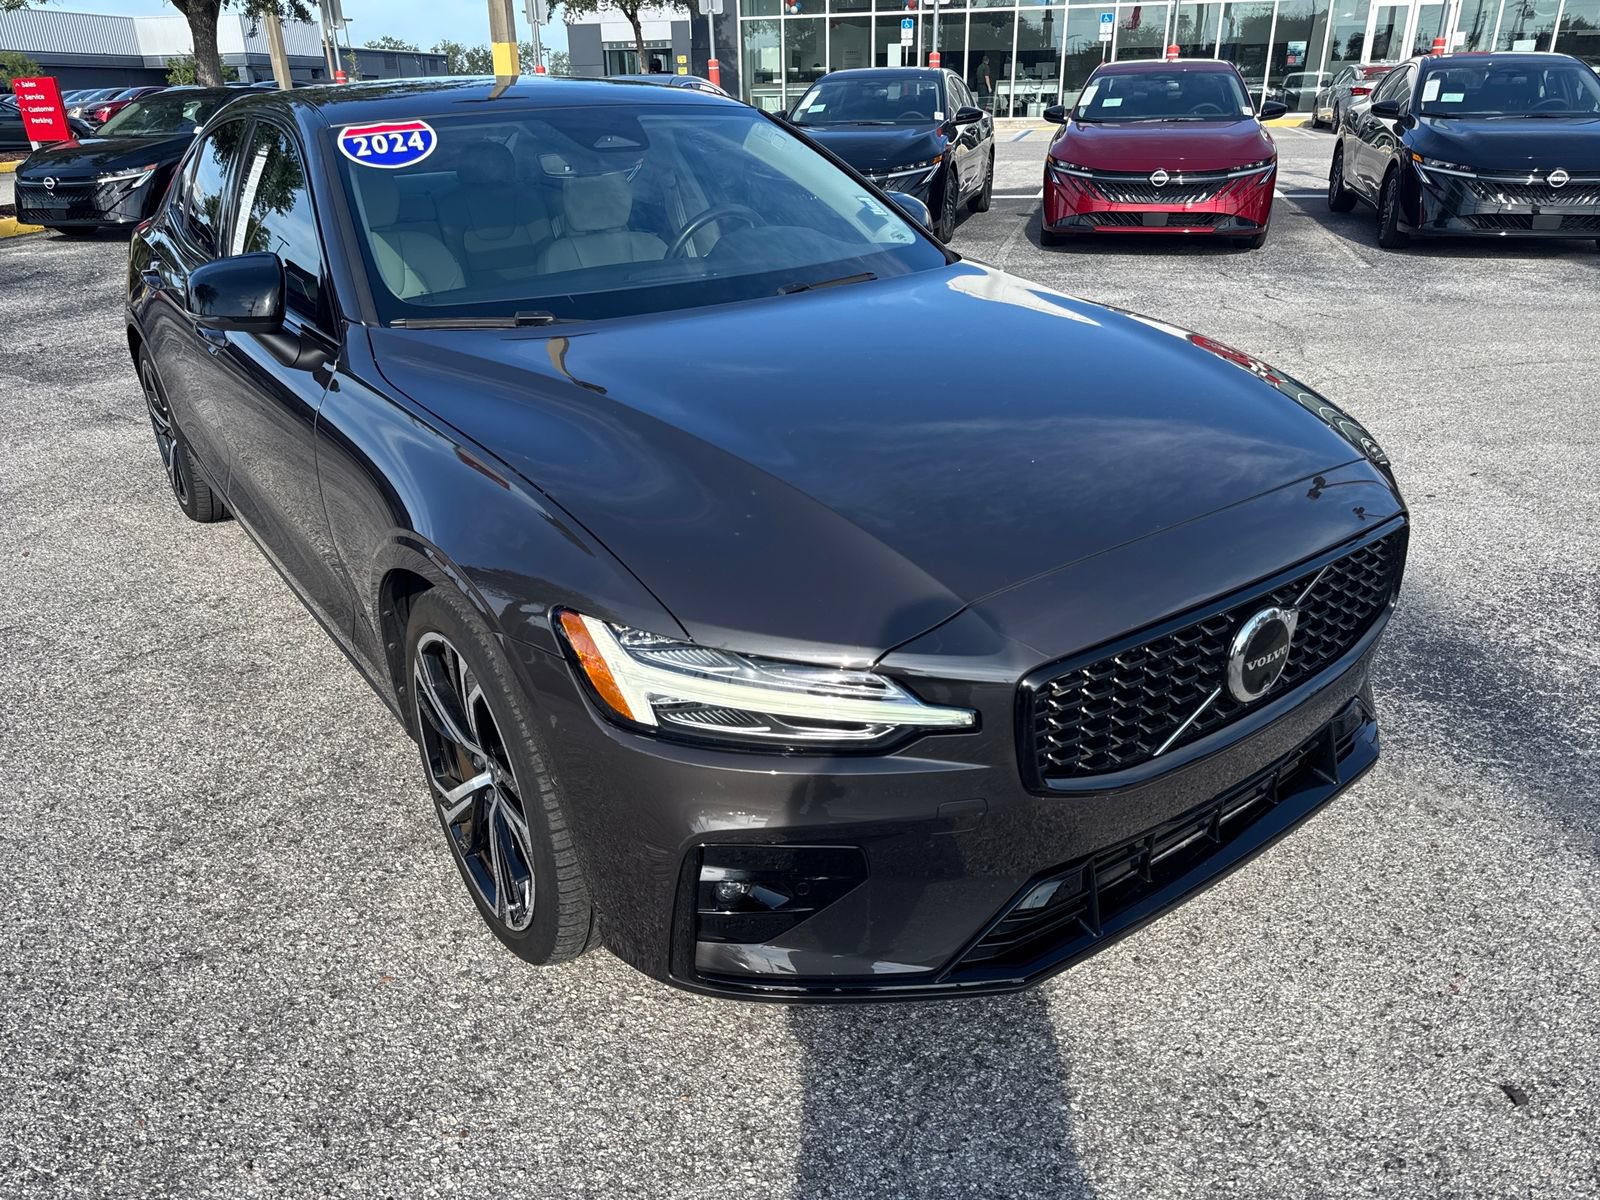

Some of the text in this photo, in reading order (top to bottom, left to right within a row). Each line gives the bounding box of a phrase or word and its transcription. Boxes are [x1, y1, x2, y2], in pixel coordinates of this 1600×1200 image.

[31, 117, 53, 125] Parking
[352, 131, 425, 157] 2024
[1246, 645, 1288, 671] VOLVO
